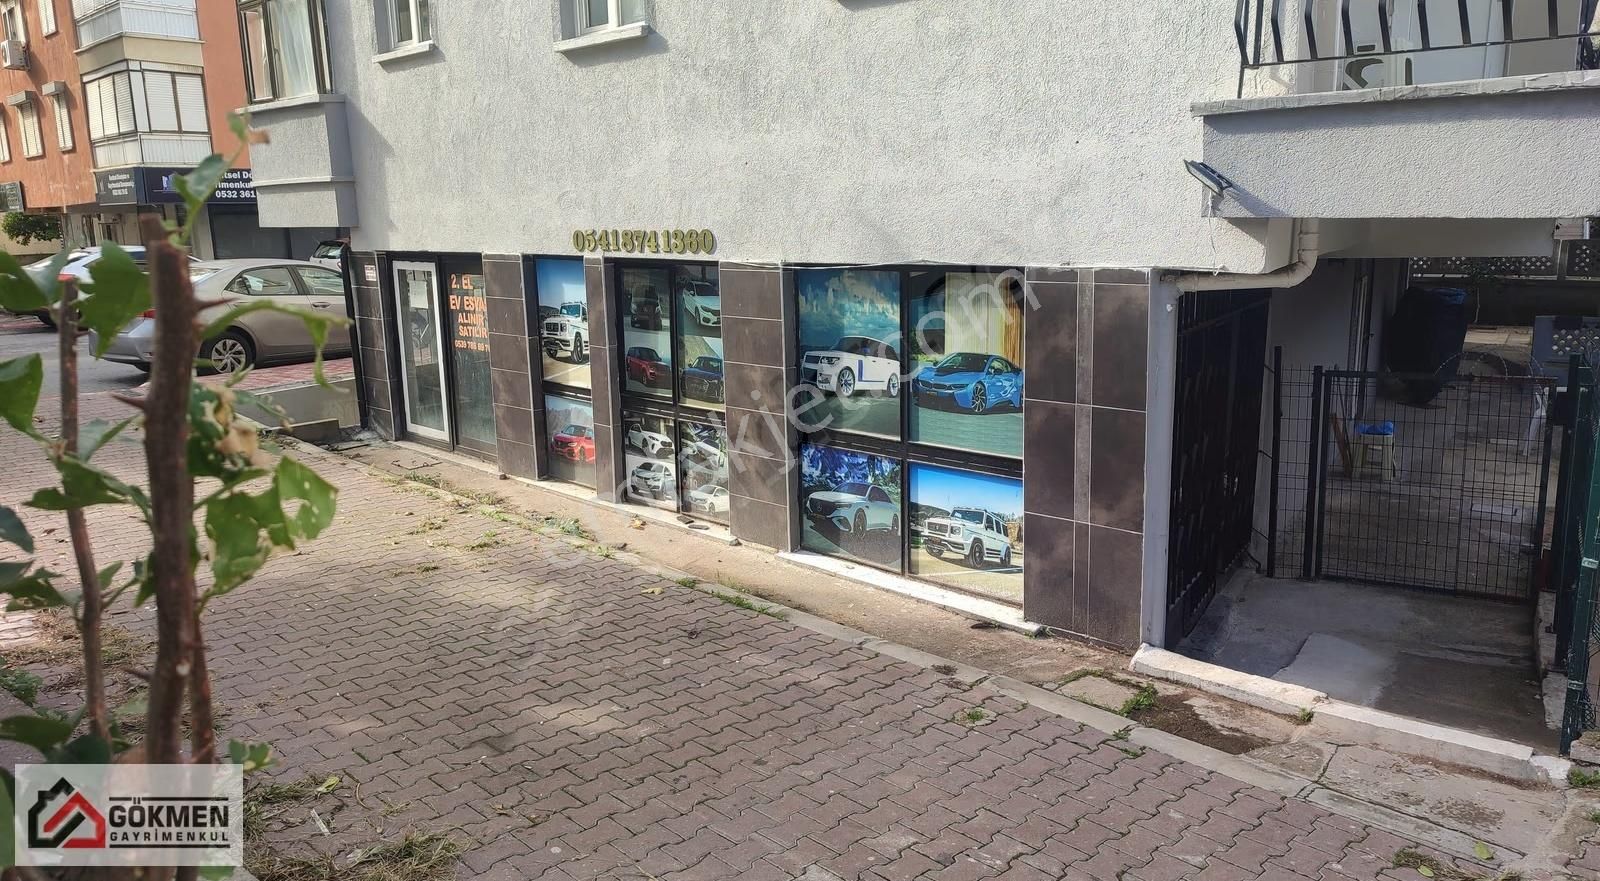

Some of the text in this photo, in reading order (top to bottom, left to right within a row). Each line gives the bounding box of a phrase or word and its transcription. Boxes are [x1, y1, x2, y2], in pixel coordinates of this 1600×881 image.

[222, 171, 241, 179] tsel
[216, 181, 253, 189] imenku
[215, 190, 257, 198] 0532 361
[450, 273, 474, 290] 2. EL
[449, 295, 461, 310] EV
[458, 312, 485, 327] ALINIR
[459, 325, 488, 339] SATILIR
